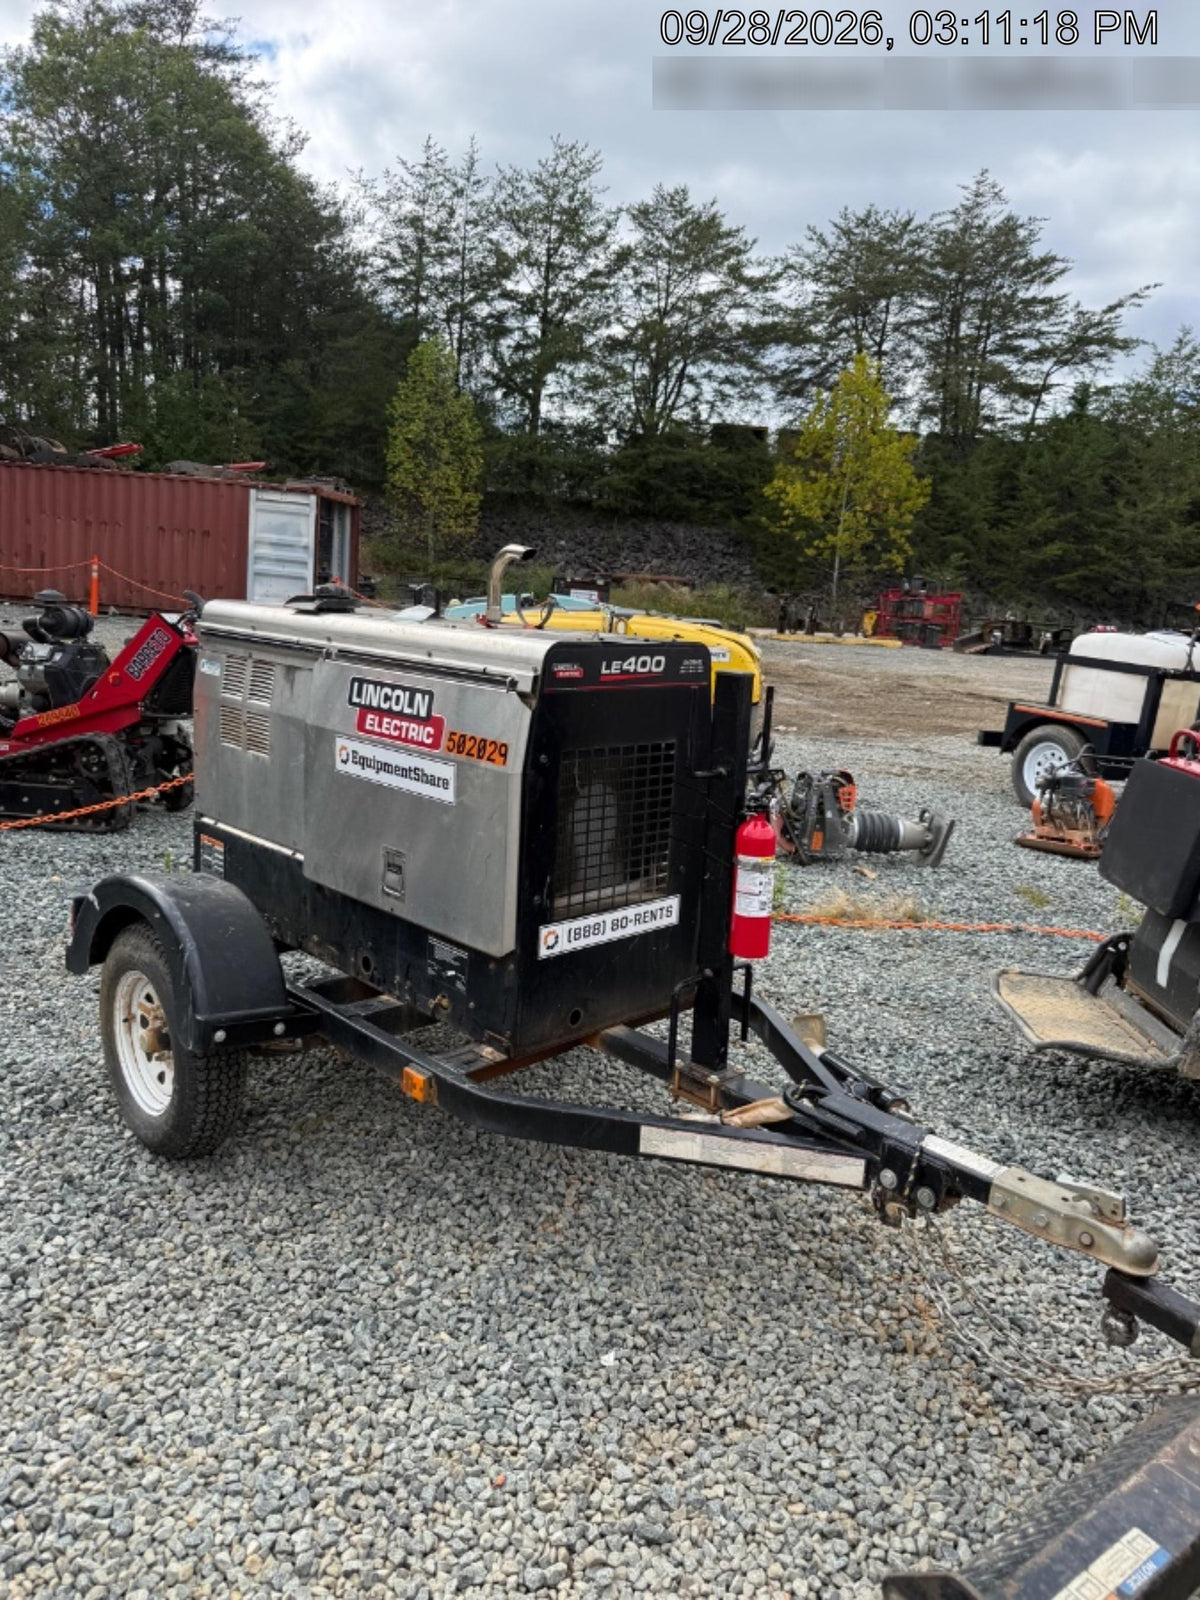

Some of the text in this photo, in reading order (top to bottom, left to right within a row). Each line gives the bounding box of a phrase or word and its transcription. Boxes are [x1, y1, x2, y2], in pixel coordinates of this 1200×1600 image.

[601, 656, 665, 674] LE400
[352, 682, 430, 717] LINCOLN
[365, 714, 434, 744] ELECTRIC
[447, 731, 508, 766] 502029
[351, 750, 449, 790] EquipmentShare
[567, 920, 606, 943] (888)
